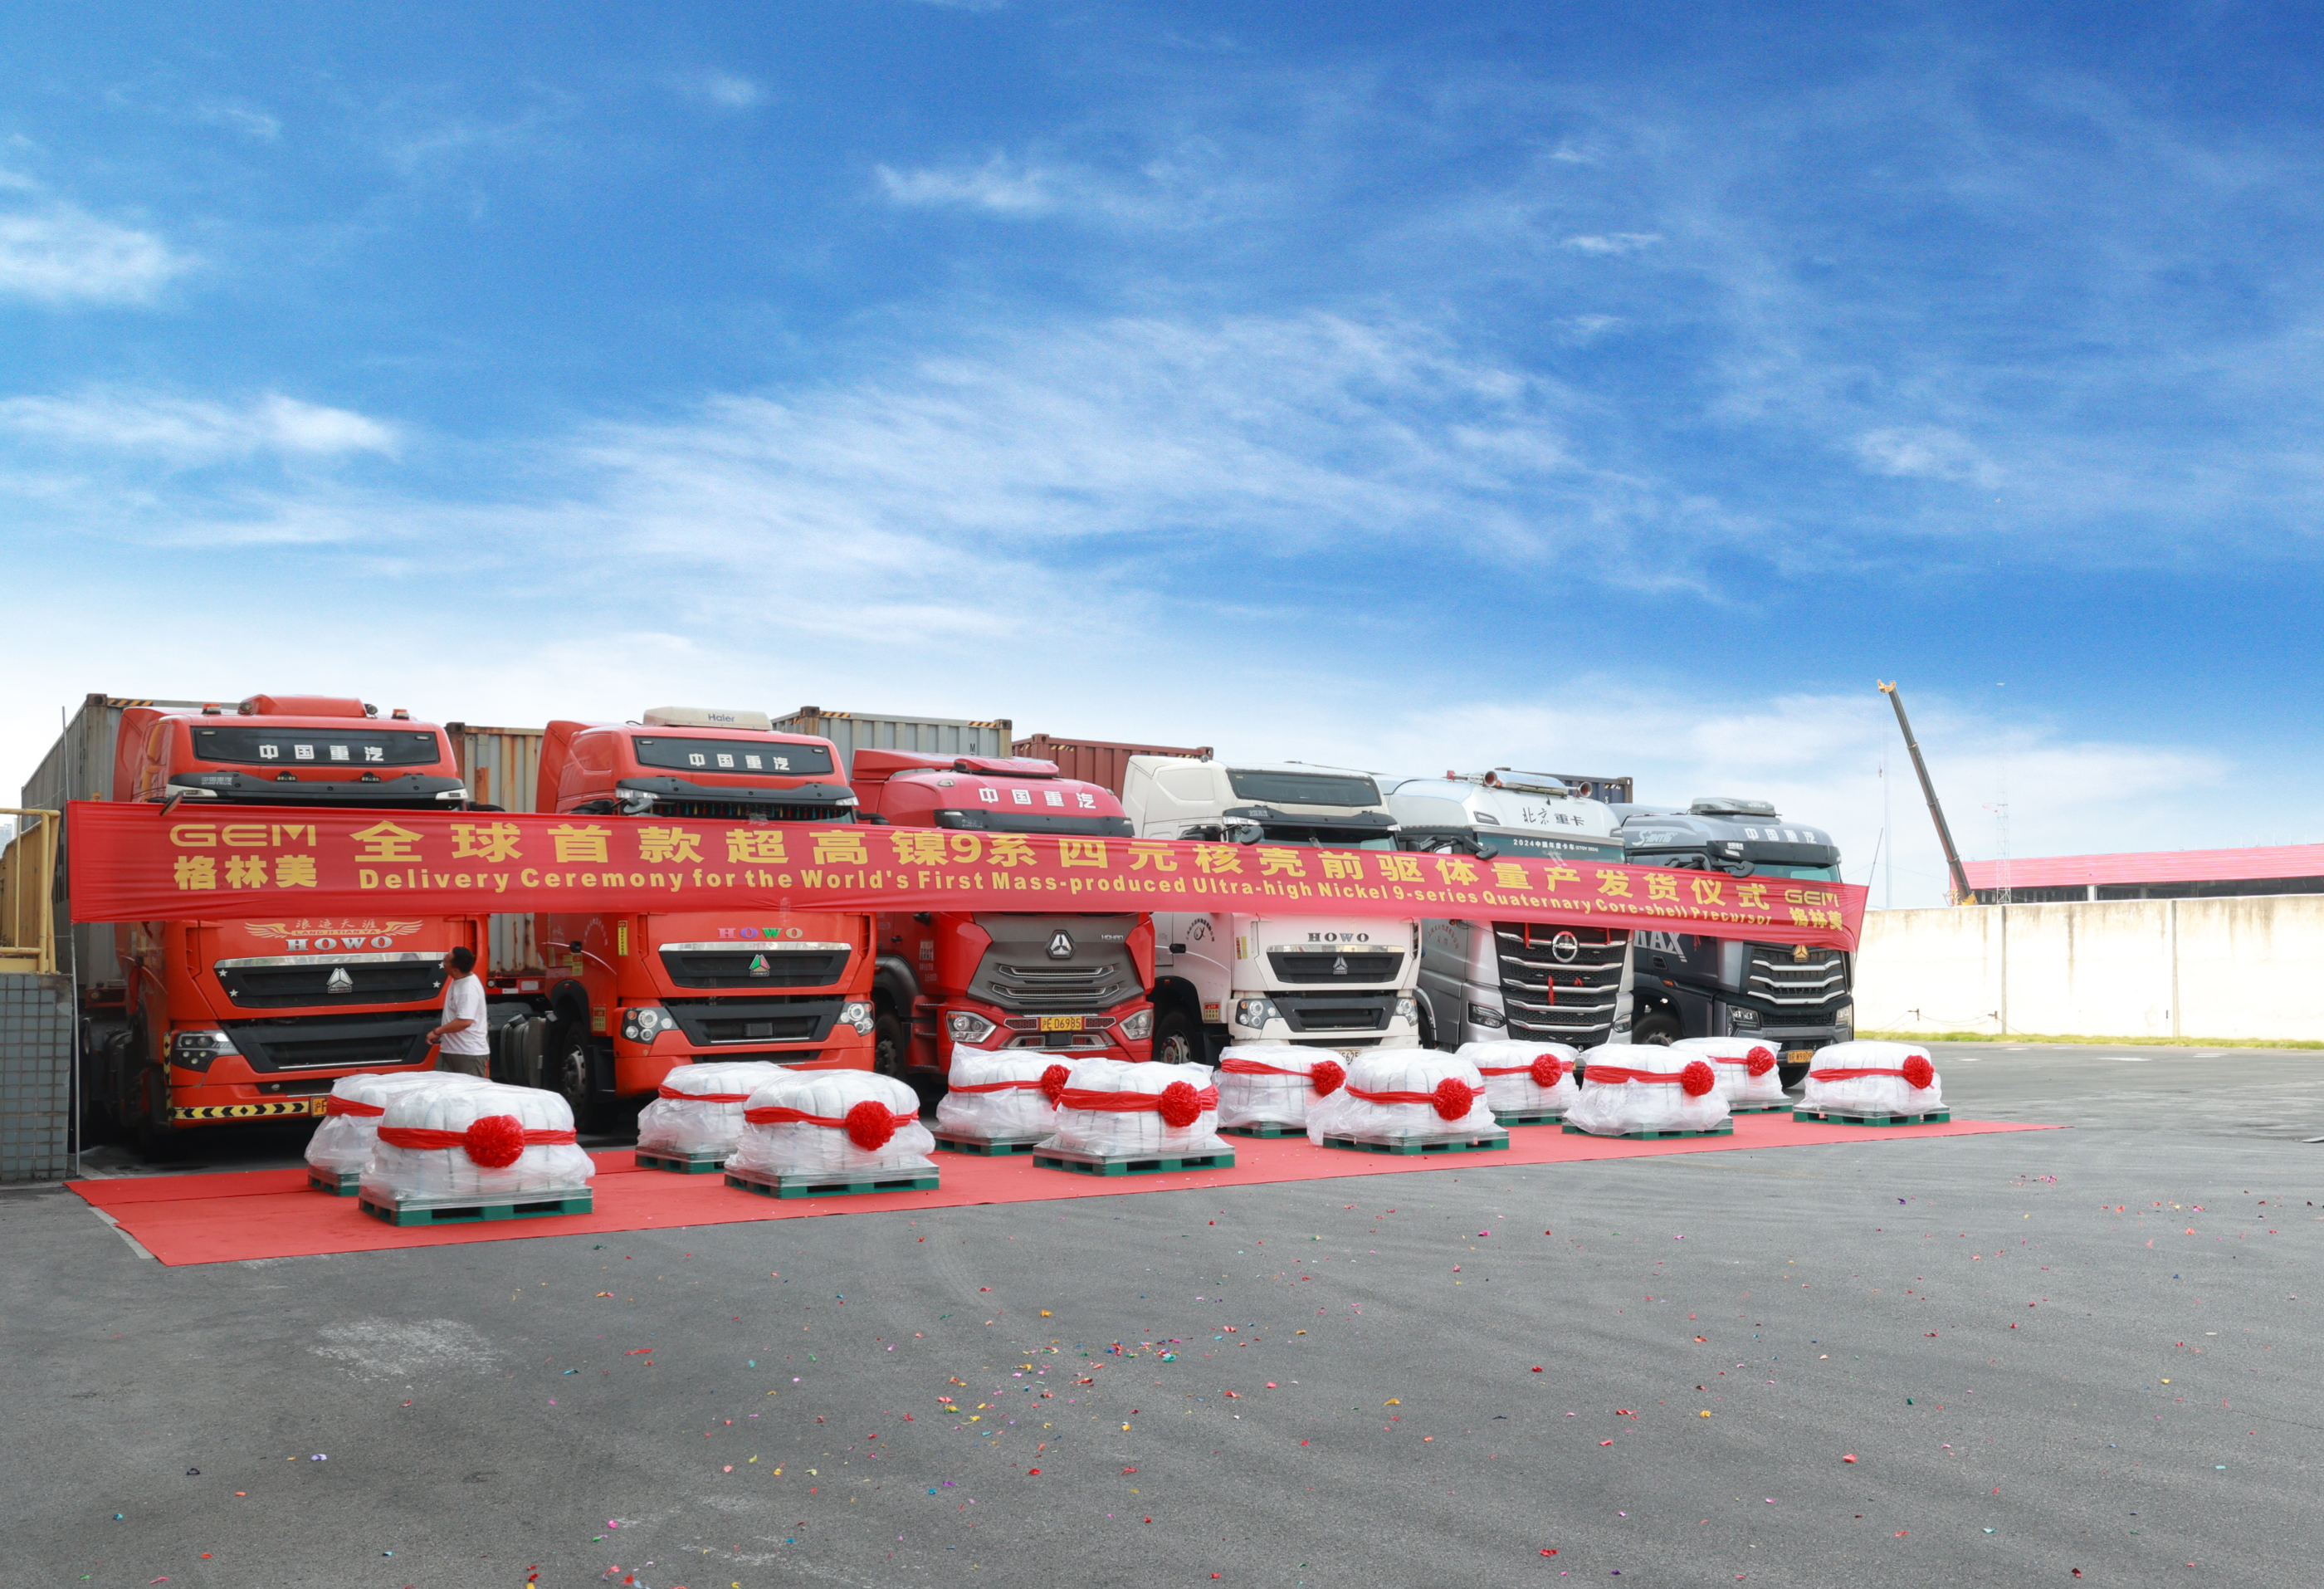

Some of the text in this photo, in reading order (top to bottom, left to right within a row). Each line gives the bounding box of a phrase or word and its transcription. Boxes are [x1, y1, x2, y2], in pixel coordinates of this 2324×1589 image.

[707, 713, 735, 723] Haier
[259, 744, 384, 762] 中国重汽
[688, 753, 790, 771] 中国重汽
[978, 787, 1097, 809] 中国重汽
[1522, 806, 1585, 827] 北京重卡
[170, 824, 316, 847] GEM
[1744, 828, 1818, 845] 中国重汽
[173, 855, 318, 890] 格林美
[349, 820, 1770, 910] 全球首款超高镍9系四元核壳前驱体量产发货仪式
[359, 868, 1772, 925] Delivery Ceremony for the World's First Mass-produced Ultra-high Nickel 9-series Quaternary Core-shell Precursor
[1784, 888, 1839, 907] GEM
[1789, 907, 1843, 931] 格林美
[717, 927, 803, 939] HOWO
[1307, 932, 1370, 942] HOWO
[286, 936, 393, 951] HOWO
